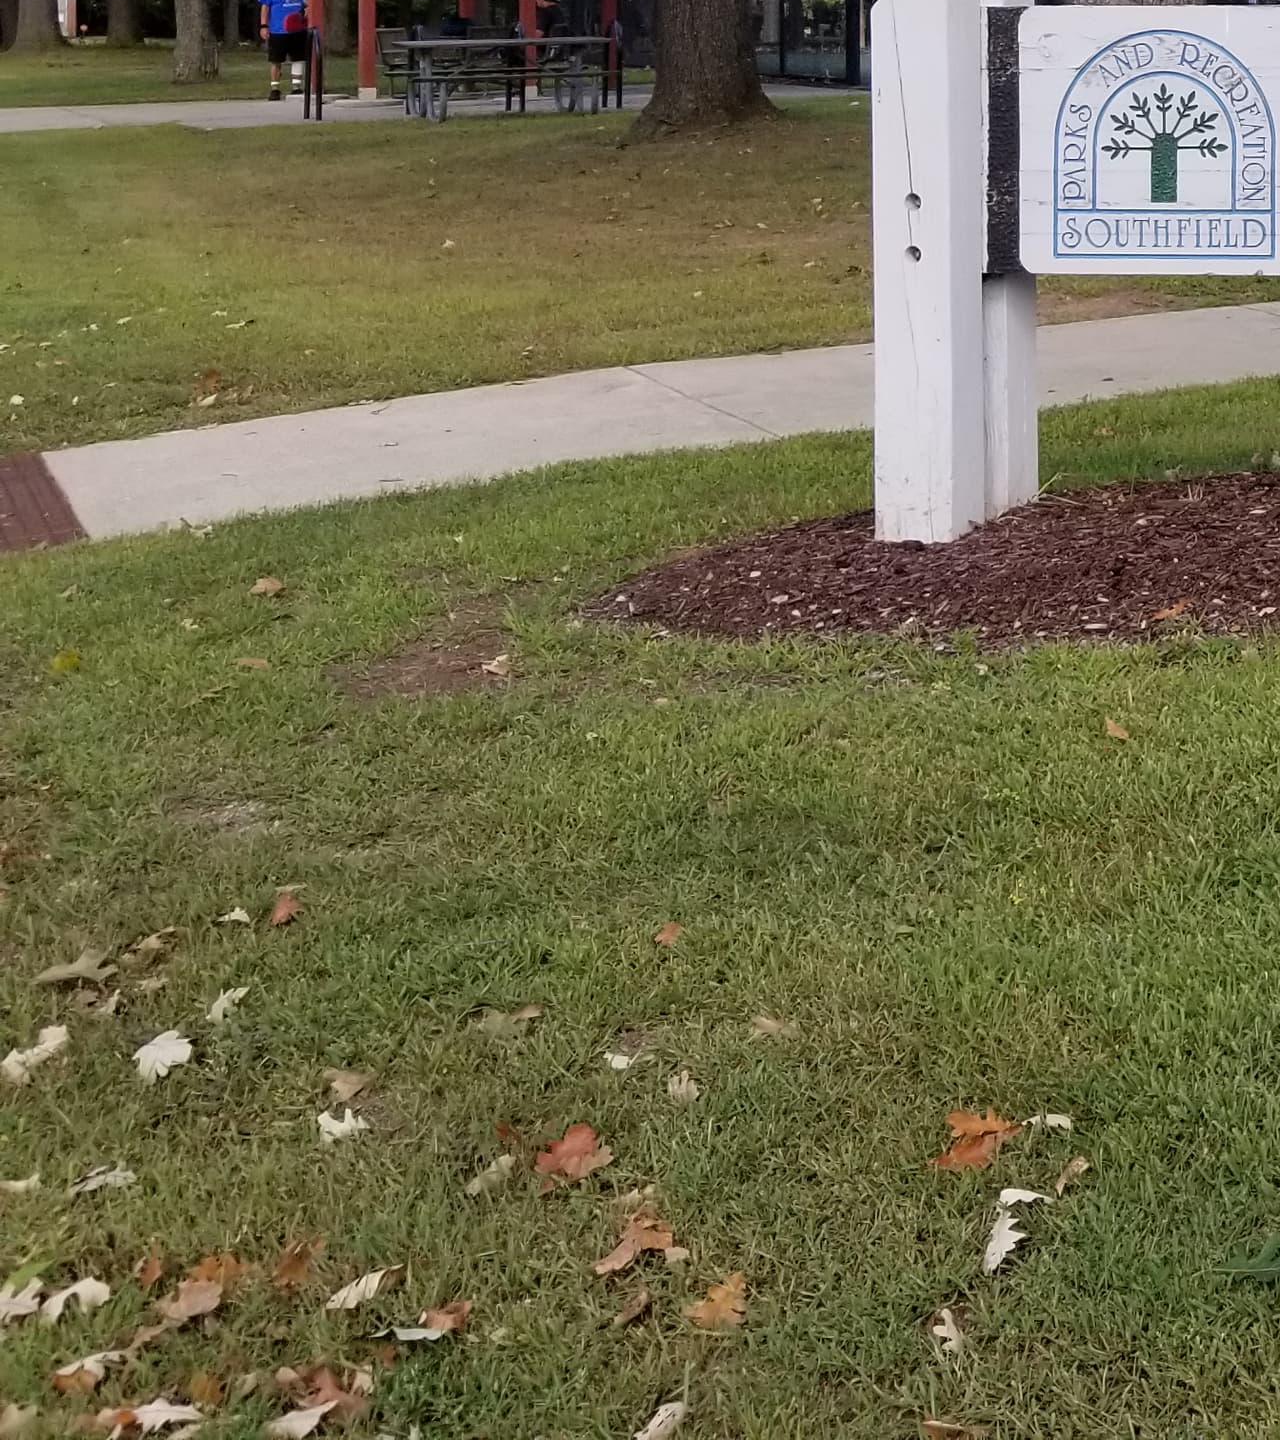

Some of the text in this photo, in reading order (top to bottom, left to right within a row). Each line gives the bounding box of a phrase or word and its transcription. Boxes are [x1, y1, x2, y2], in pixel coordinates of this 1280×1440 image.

[1062, 41, 1267, 203] PARKS AND RECREATION
[1061, 216, 1267, 249] SOUTHFIELD
